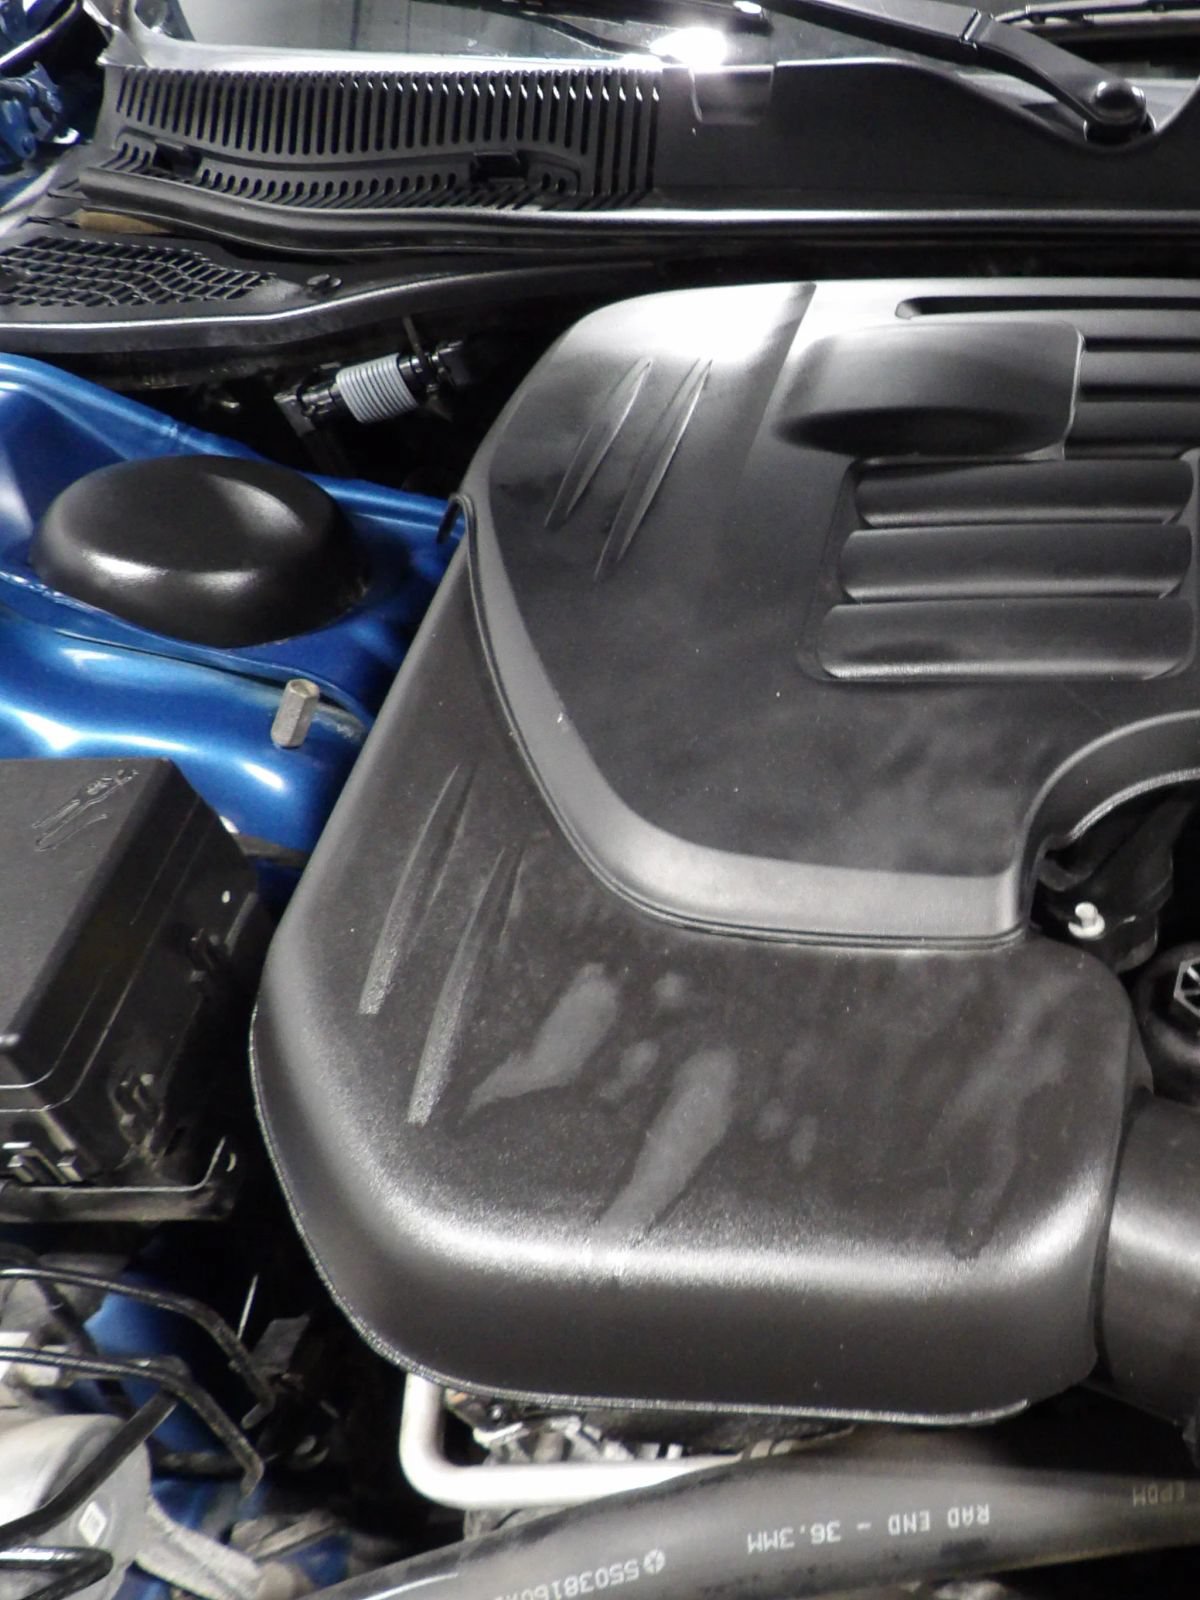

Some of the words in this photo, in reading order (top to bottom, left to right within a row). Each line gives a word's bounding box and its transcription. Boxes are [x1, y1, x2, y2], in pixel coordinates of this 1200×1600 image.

[887, 1510, 931, 1536] END
[947, 1504, 991, 1528] RAD
[747, 1520, 842, 1554] 36.3MM
[494, 1558, 640, 1600] 55038160
